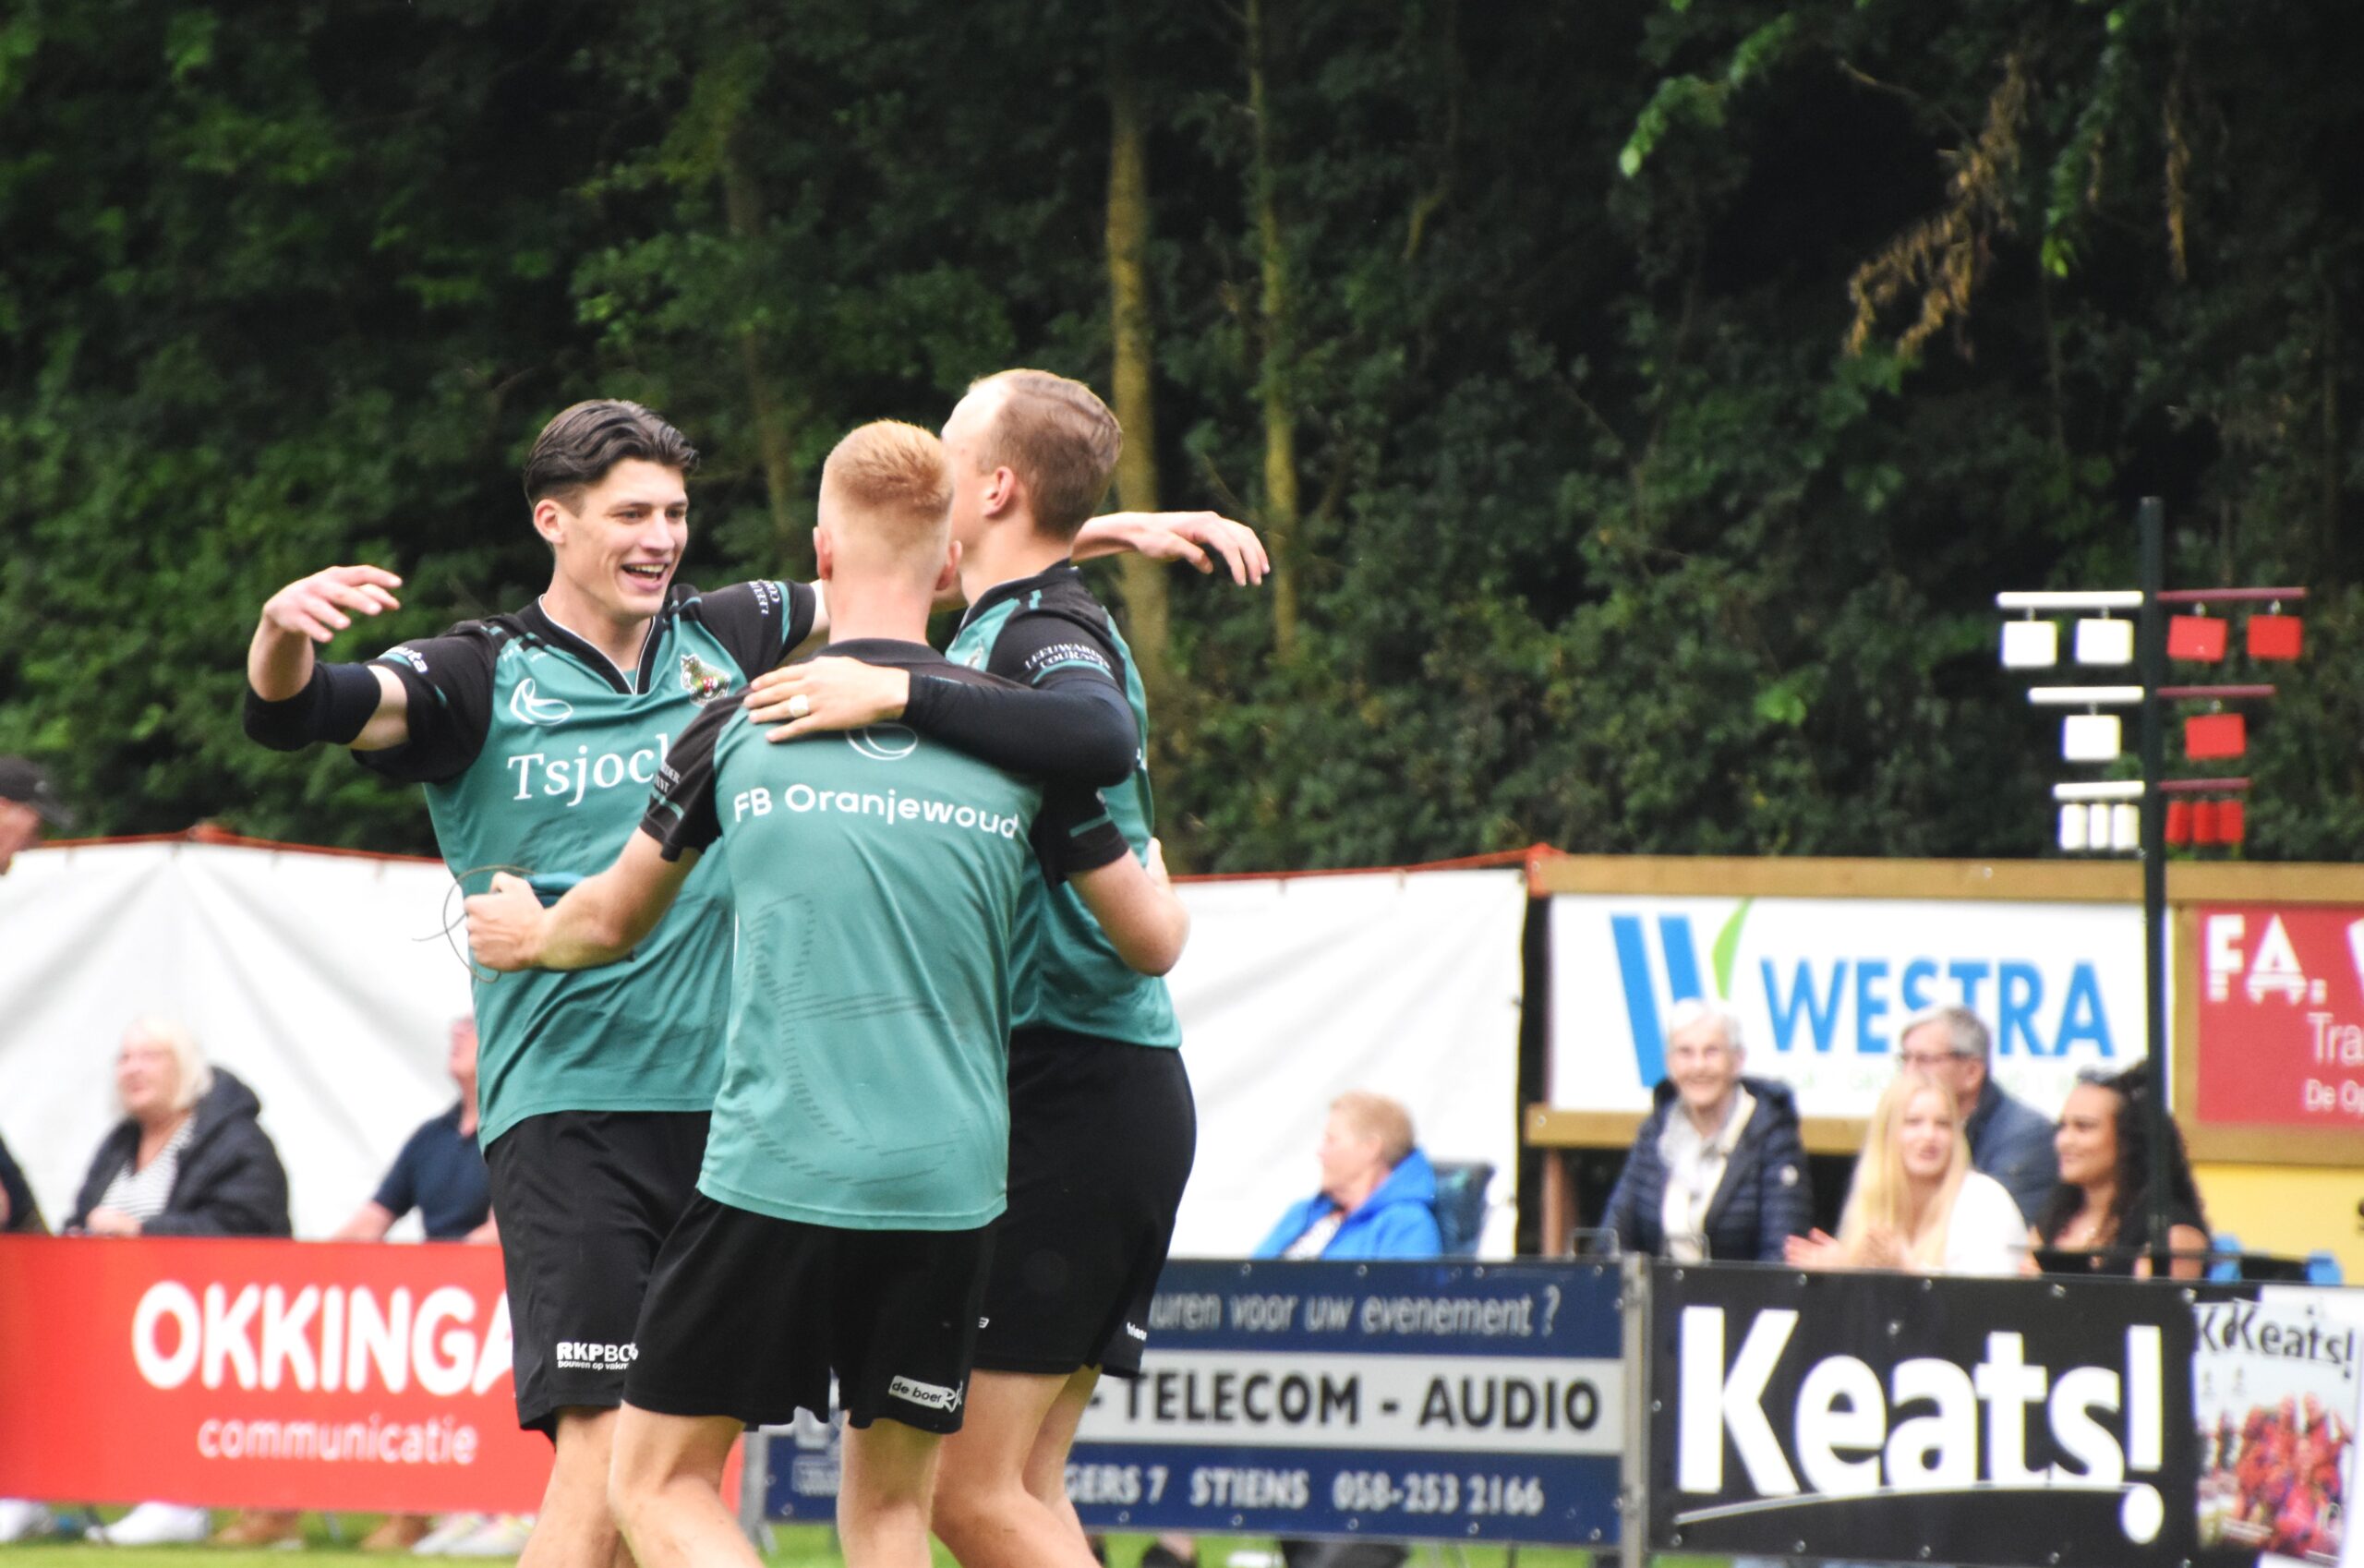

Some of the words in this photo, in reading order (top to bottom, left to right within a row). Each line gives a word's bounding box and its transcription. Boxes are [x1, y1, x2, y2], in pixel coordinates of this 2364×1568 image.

[733, 787, 773, 822] FB
[785, 783, 1019, 839] Oranjewoud
[1759, 957, 2116, 1056] WESTRA
[2306, 1011, 2364, 1067] Tra
[2304, 1079, 2336, 1112] De
[1148, 1293, 1222, 1331] uren
[1230, 1294, 1298, 1333] voor
[1303, 1295, 1355, 1333] uw
[1360, 1294, 1534, 1337] evenement
[891, 1381, 910, 1394] de
[912, 1386, 942, 1404] boer
[1119, 1373, 1361, 1427] TELECOM
[1417, 1376, 1602, 1432] AUDIO
[197, 1414, 479, 1465] communicatie
[1677, 1305, 2165, 1546] Keats!
[1189, 1466, 1309, 1510] STIENS
[1466, 1472, 1545, 1517] 2166
